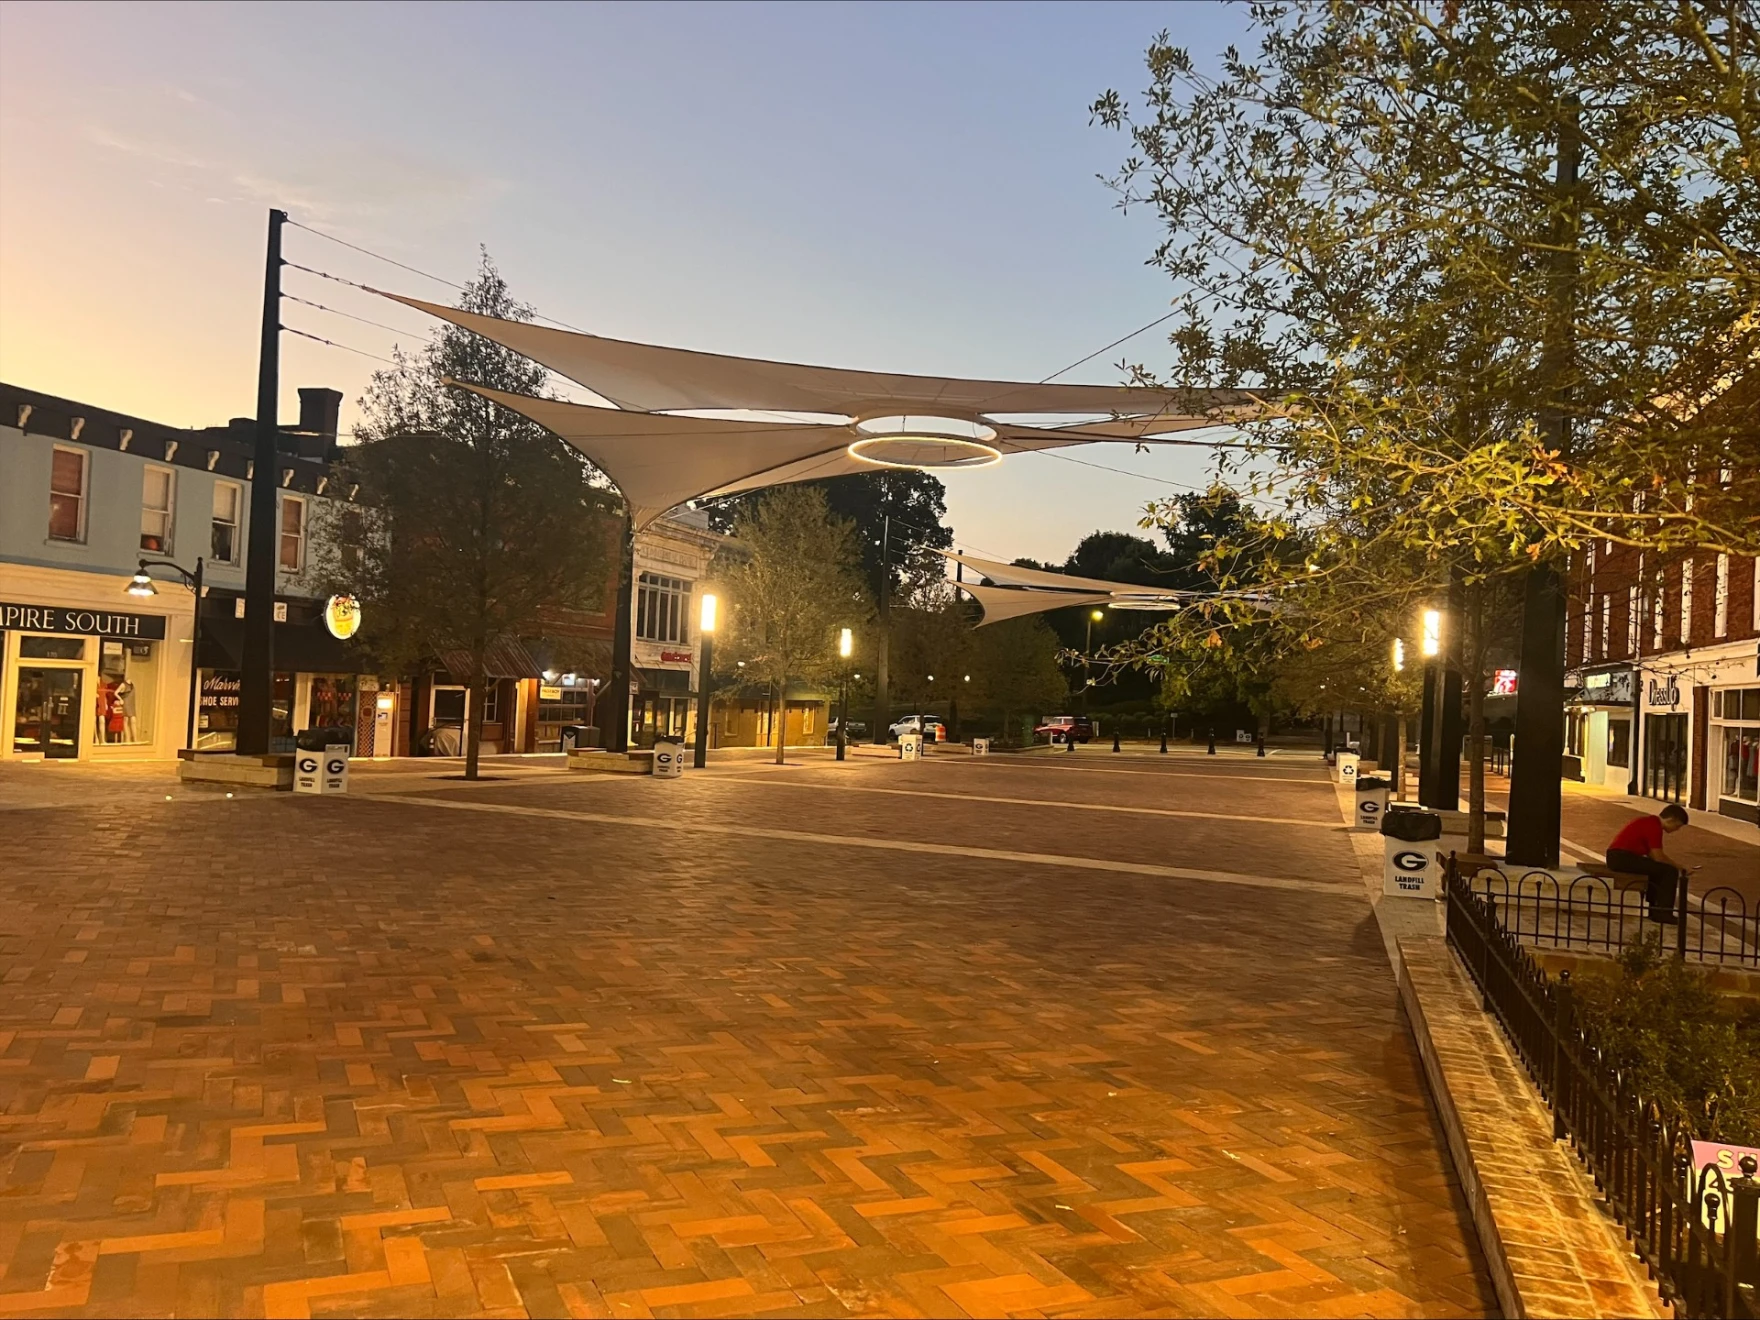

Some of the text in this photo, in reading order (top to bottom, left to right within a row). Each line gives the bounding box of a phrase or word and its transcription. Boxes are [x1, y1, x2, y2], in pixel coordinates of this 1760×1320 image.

[65, 611, 139, 635] SOUTH
[299, 758, 318, 773] G
[327, 759, 345, 774] G
[1360, 801, 1379, 813] G
[1393, 851, 1429, 872] G
[1394, 875, 1424, 884] LANDFILL
[1399, 883, 1421, 891] TRASH
